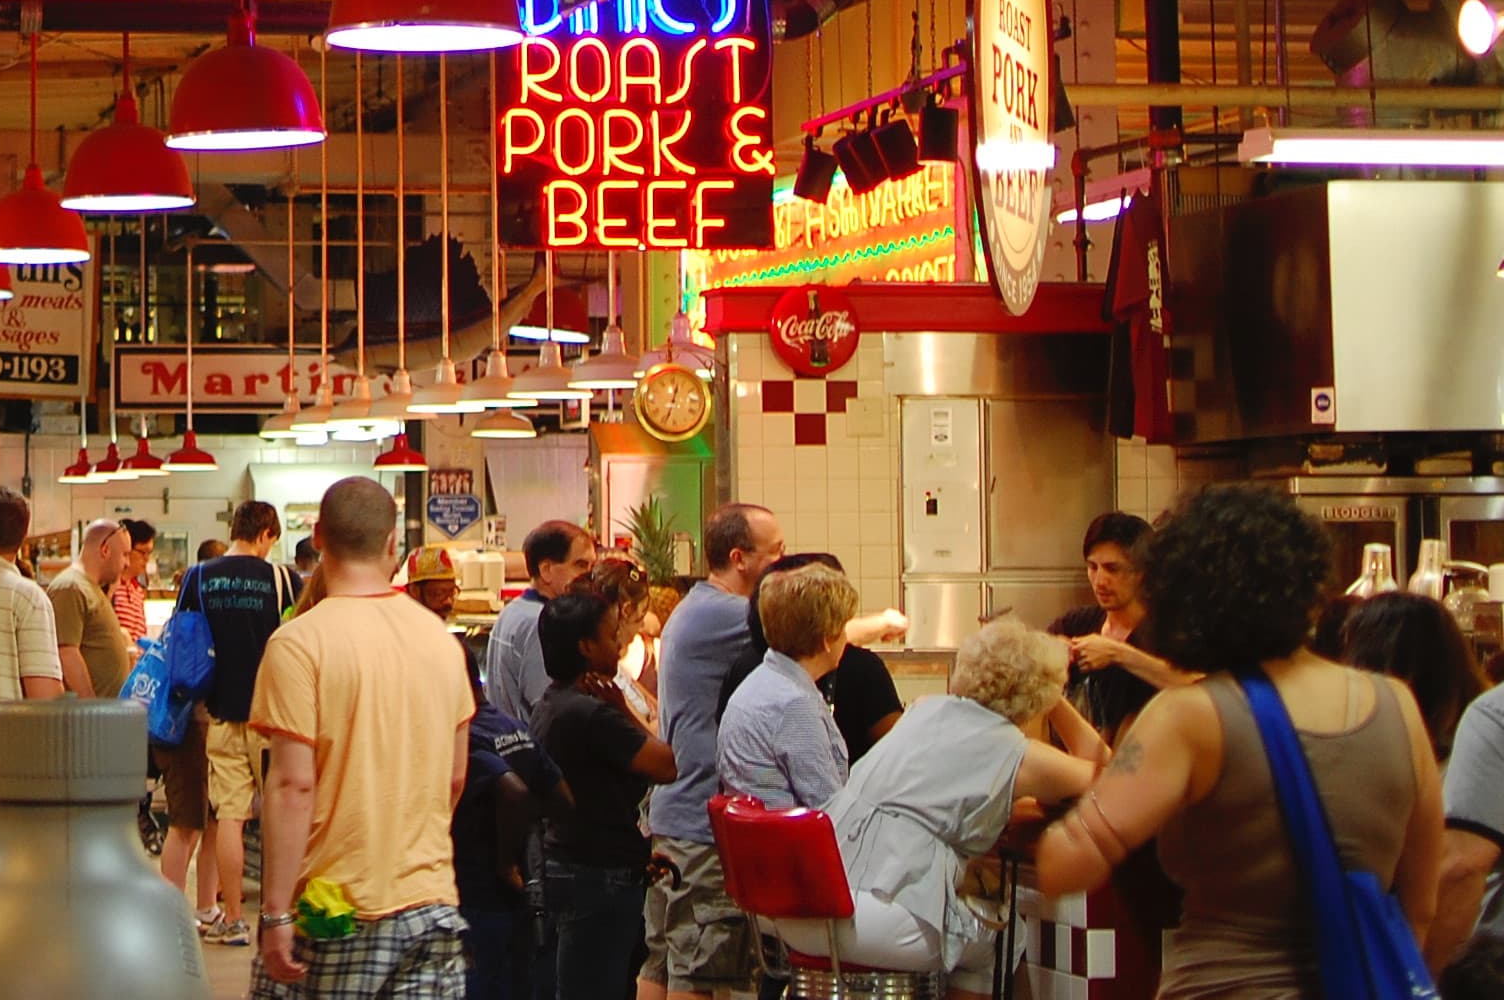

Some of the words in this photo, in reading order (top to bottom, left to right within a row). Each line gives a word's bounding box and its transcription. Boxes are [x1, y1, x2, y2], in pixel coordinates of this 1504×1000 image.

[520, 37, 756, 103] ROAST
[992, 45, 1039, 130] PORK
[502, 107, 693, 176] PORK
[731, 106, 776, 176] &
[546, 180, 735, 247] BEEF
[995, 168, 1038, 225] BEEF
[19, 293, 84, 311] meats
[780, 310, 855, 347] Coca-Cola
